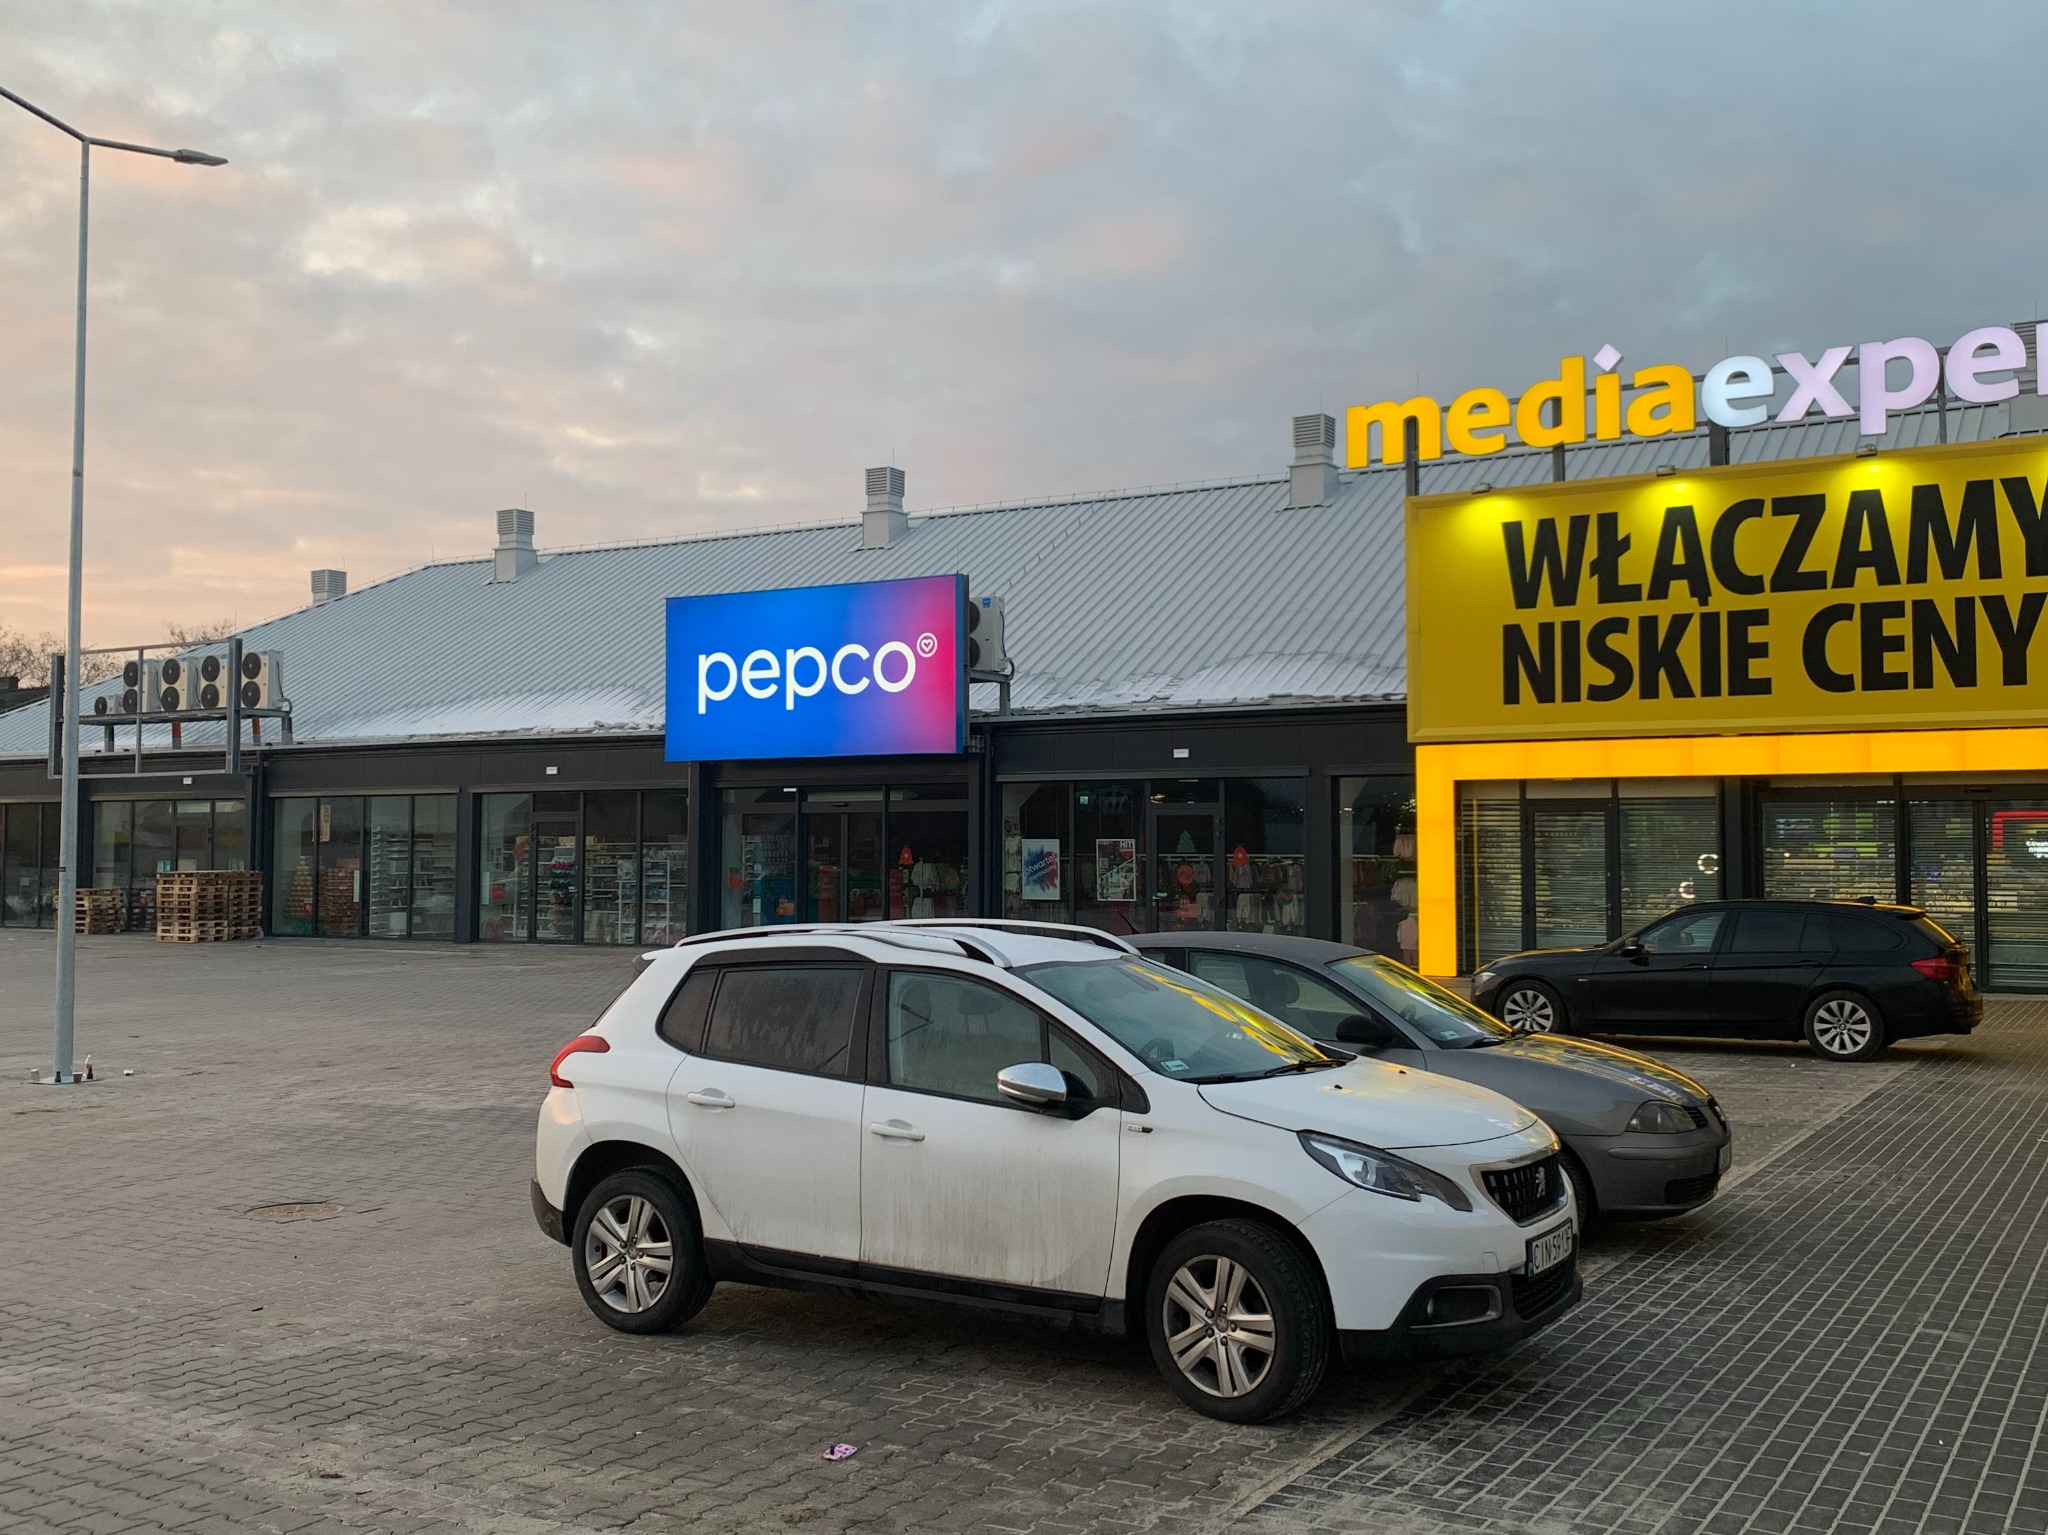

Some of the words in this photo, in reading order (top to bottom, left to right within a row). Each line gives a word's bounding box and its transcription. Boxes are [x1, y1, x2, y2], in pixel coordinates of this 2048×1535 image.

[1346, 323, 2048, 469] mediaexpe
[1501, 477, 2048, 609] WŁĄCZAMY
[697, 641, 916, 714] pepco
[1503, 609, 1772, 706] NISKIE
[1802, 592, 2048, 693] CENY
